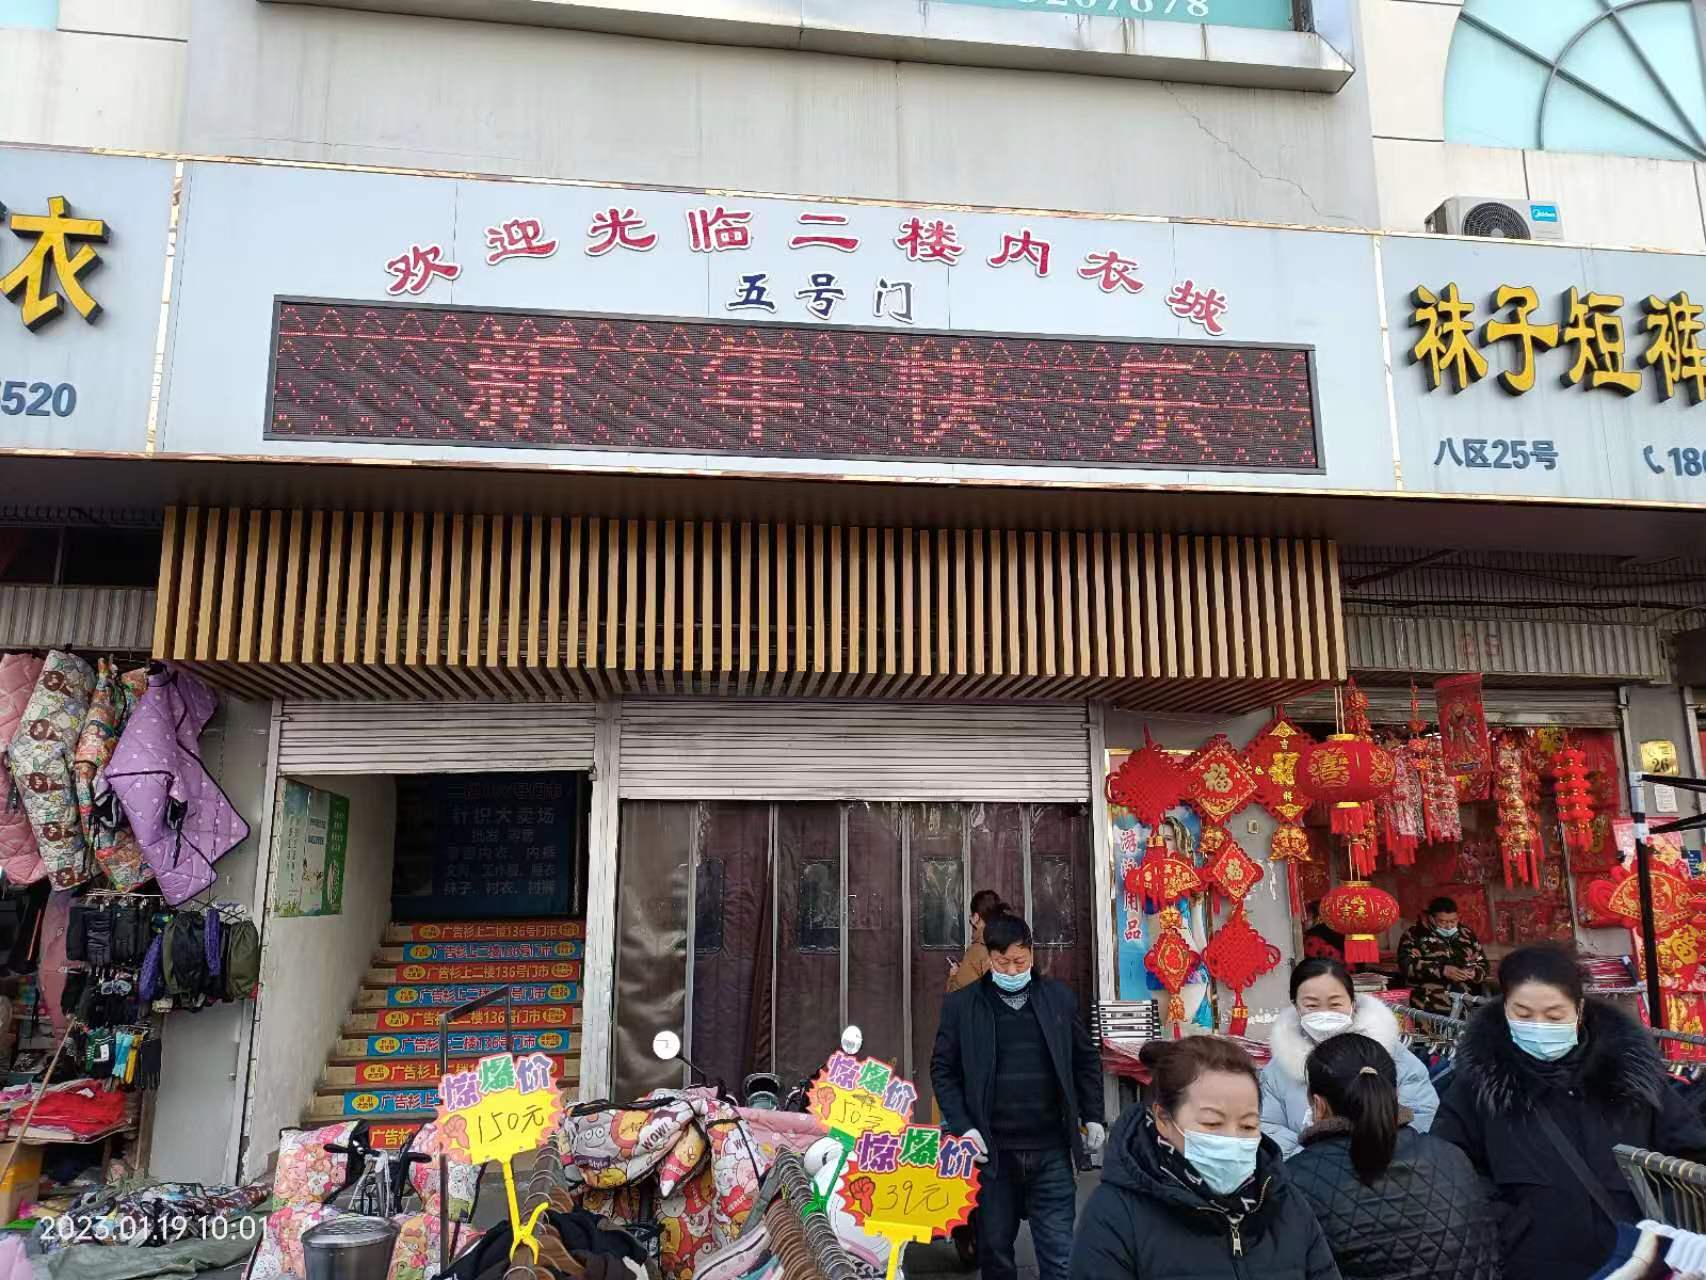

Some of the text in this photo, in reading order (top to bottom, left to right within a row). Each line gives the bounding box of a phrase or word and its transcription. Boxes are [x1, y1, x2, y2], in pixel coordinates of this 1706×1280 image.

[0, 195, 110, 333] 衣
[386, 207, 1227, 334] 欢迎光临二楼内衣城
[727, 273, 915, 322] 五号门
[1410, 282, 1706, 404] 袜子短裤
[0, 379, 77, 417] 520
[465, 326, 1208, 450] 新年快乐
[1434, 437, 1558, 470] 八区25号
[426, 964, 550, 980] 广告衫上二楼136号门市
[419, 987, 546, 1003] 广告衫上二楼号门市
[401, 1034, 536, 1052] 广告衫二楼136号门市
[477, 1104, 545, 1144] 150元
[641, 1122, 671, 1150] WOW!
[857, 1127, 981, 1179] 惊爆价
[879, 1180, 949, 1216] 39元
